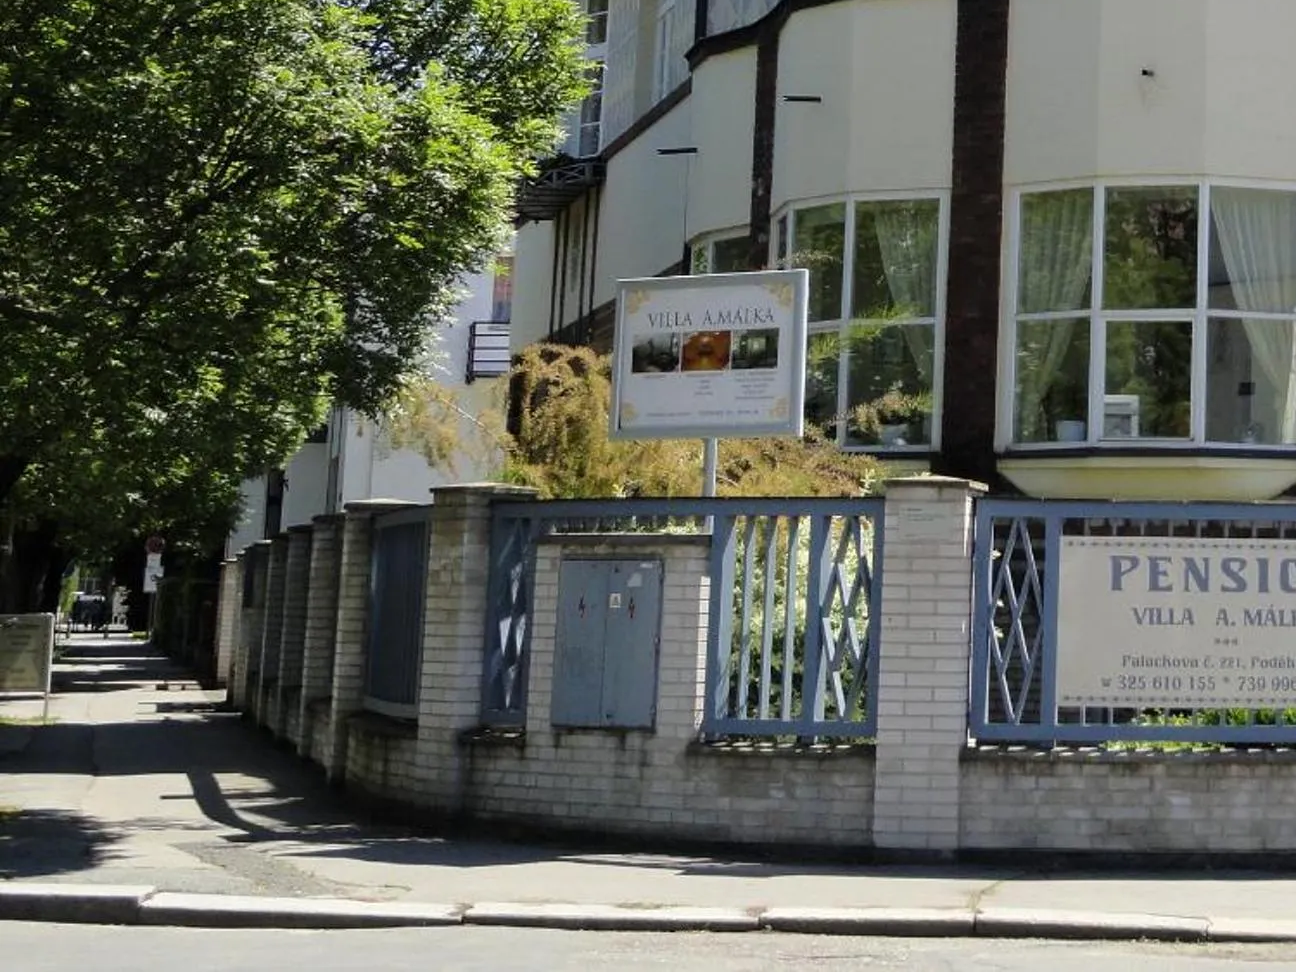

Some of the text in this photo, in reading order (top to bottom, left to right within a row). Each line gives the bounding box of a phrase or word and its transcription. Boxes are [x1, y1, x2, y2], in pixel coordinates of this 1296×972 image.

[648, 311, 692, 328] VILLA
[1132, 607, 1195, 627] VILLA
[1215, 607, 1237, 628] A.
[1118, 674, 1148, 692] 325
